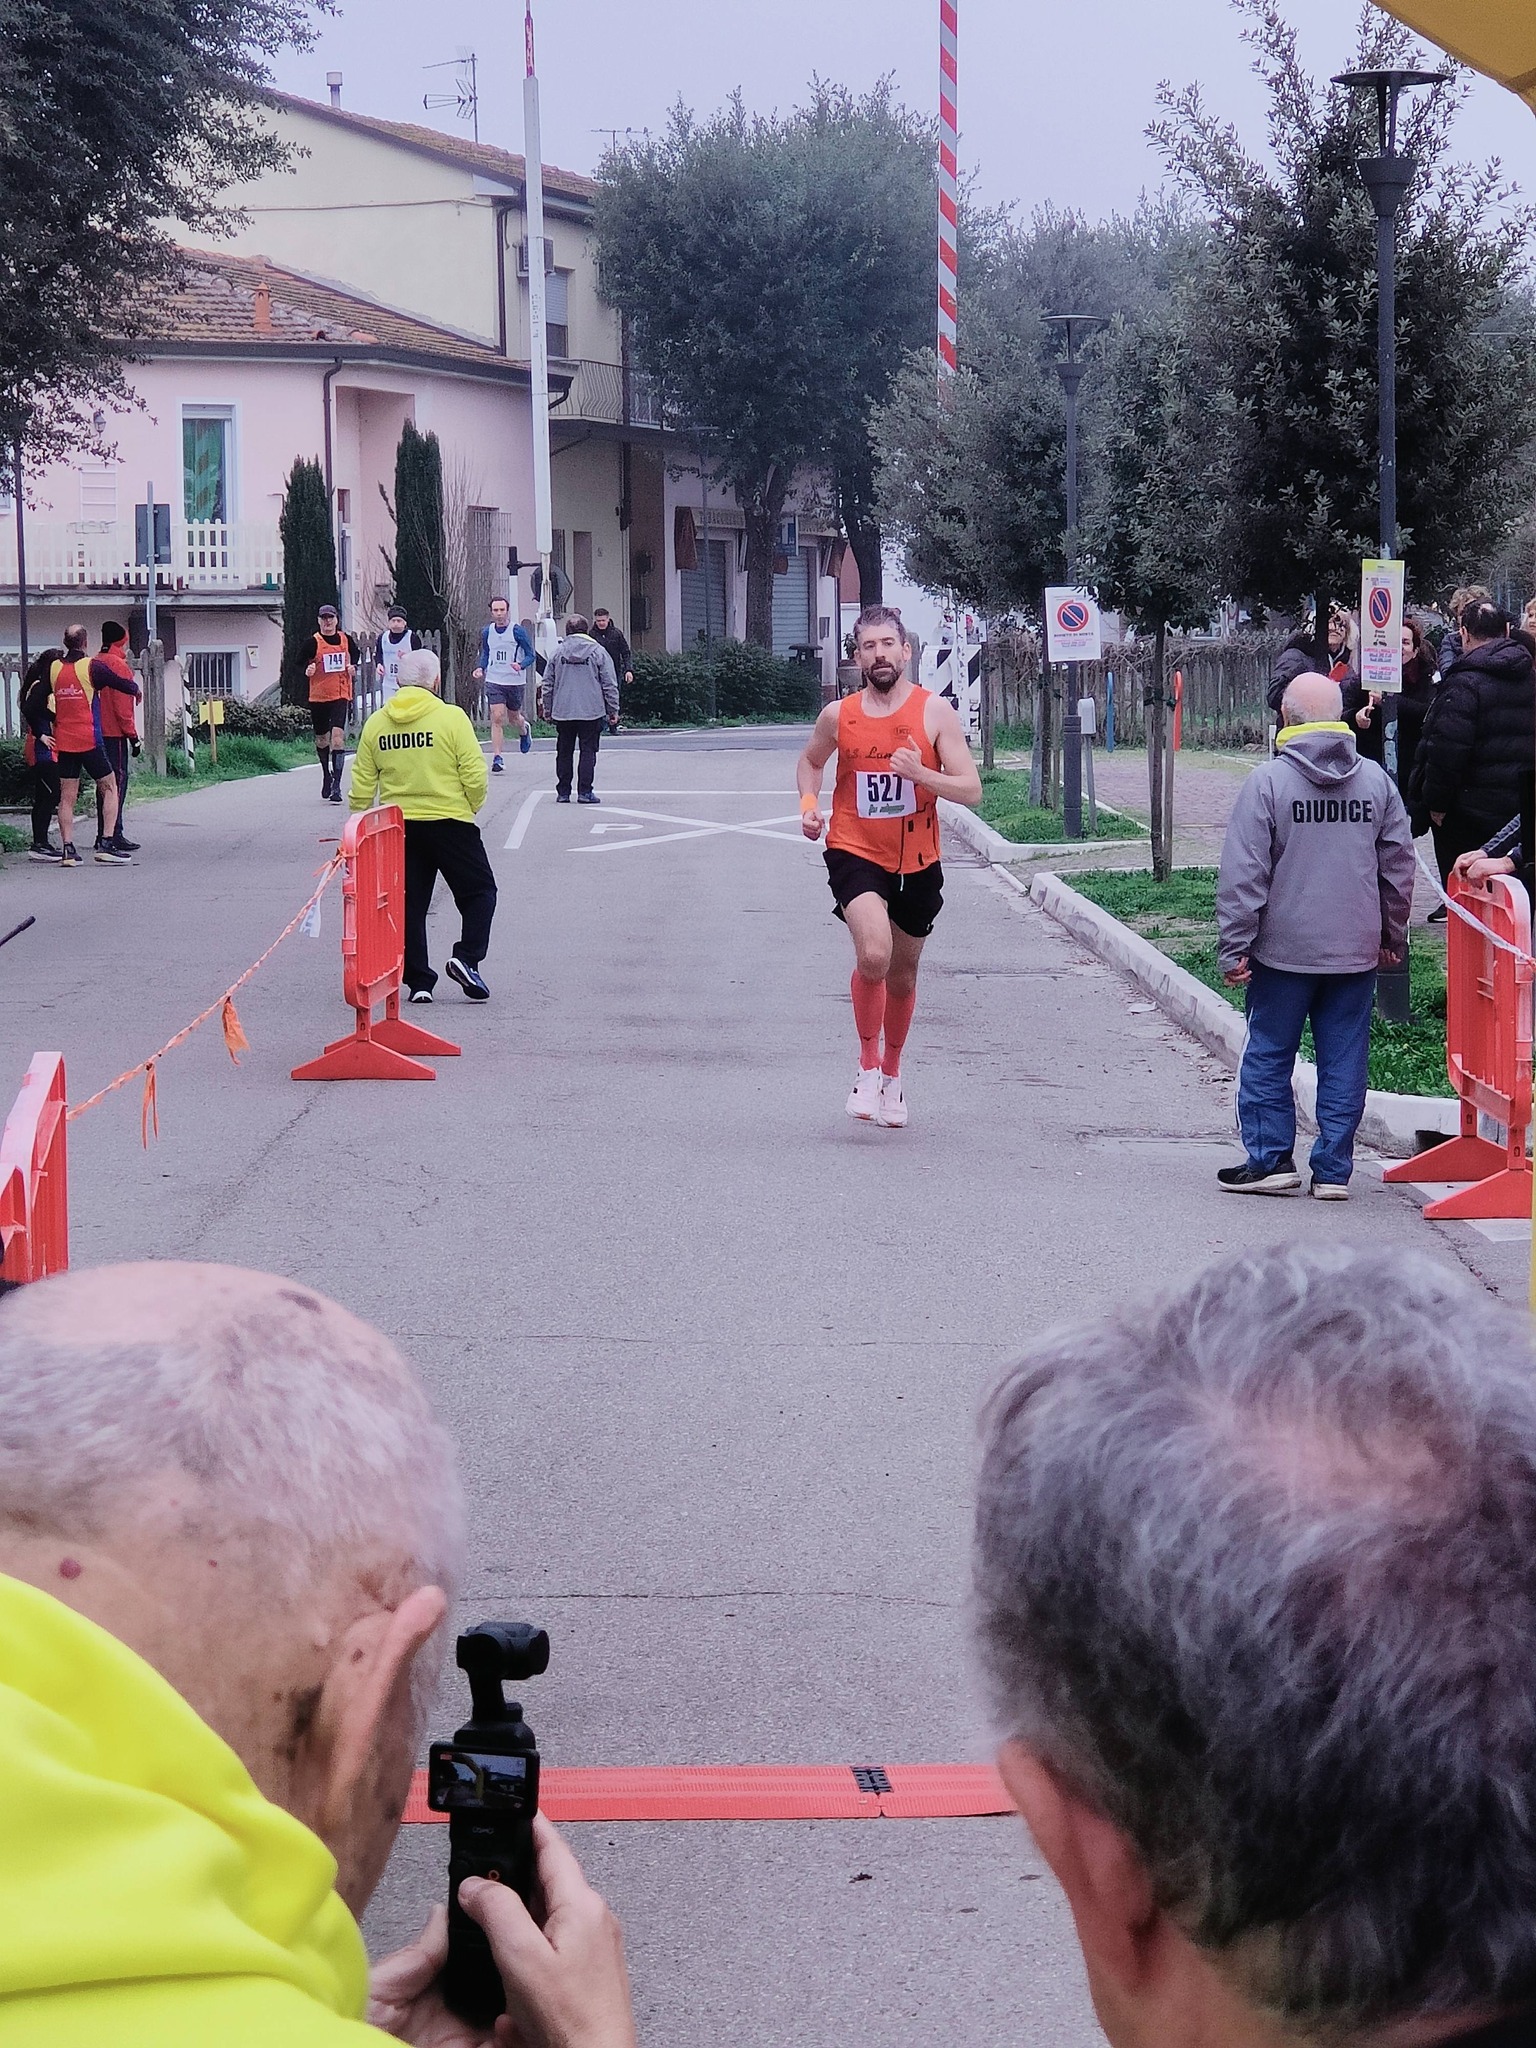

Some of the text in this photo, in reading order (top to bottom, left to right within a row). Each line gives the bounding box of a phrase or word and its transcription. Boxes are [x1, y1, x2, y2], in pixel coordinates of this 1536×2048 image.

[328, 653, 343, 665] 744
[496, 650, 507, 661] 611
[378, 731, 434, 751] GIUDICE
[866, 773, 903, 802] 527
[1292, 799, 1373, 823] GIUDICE
